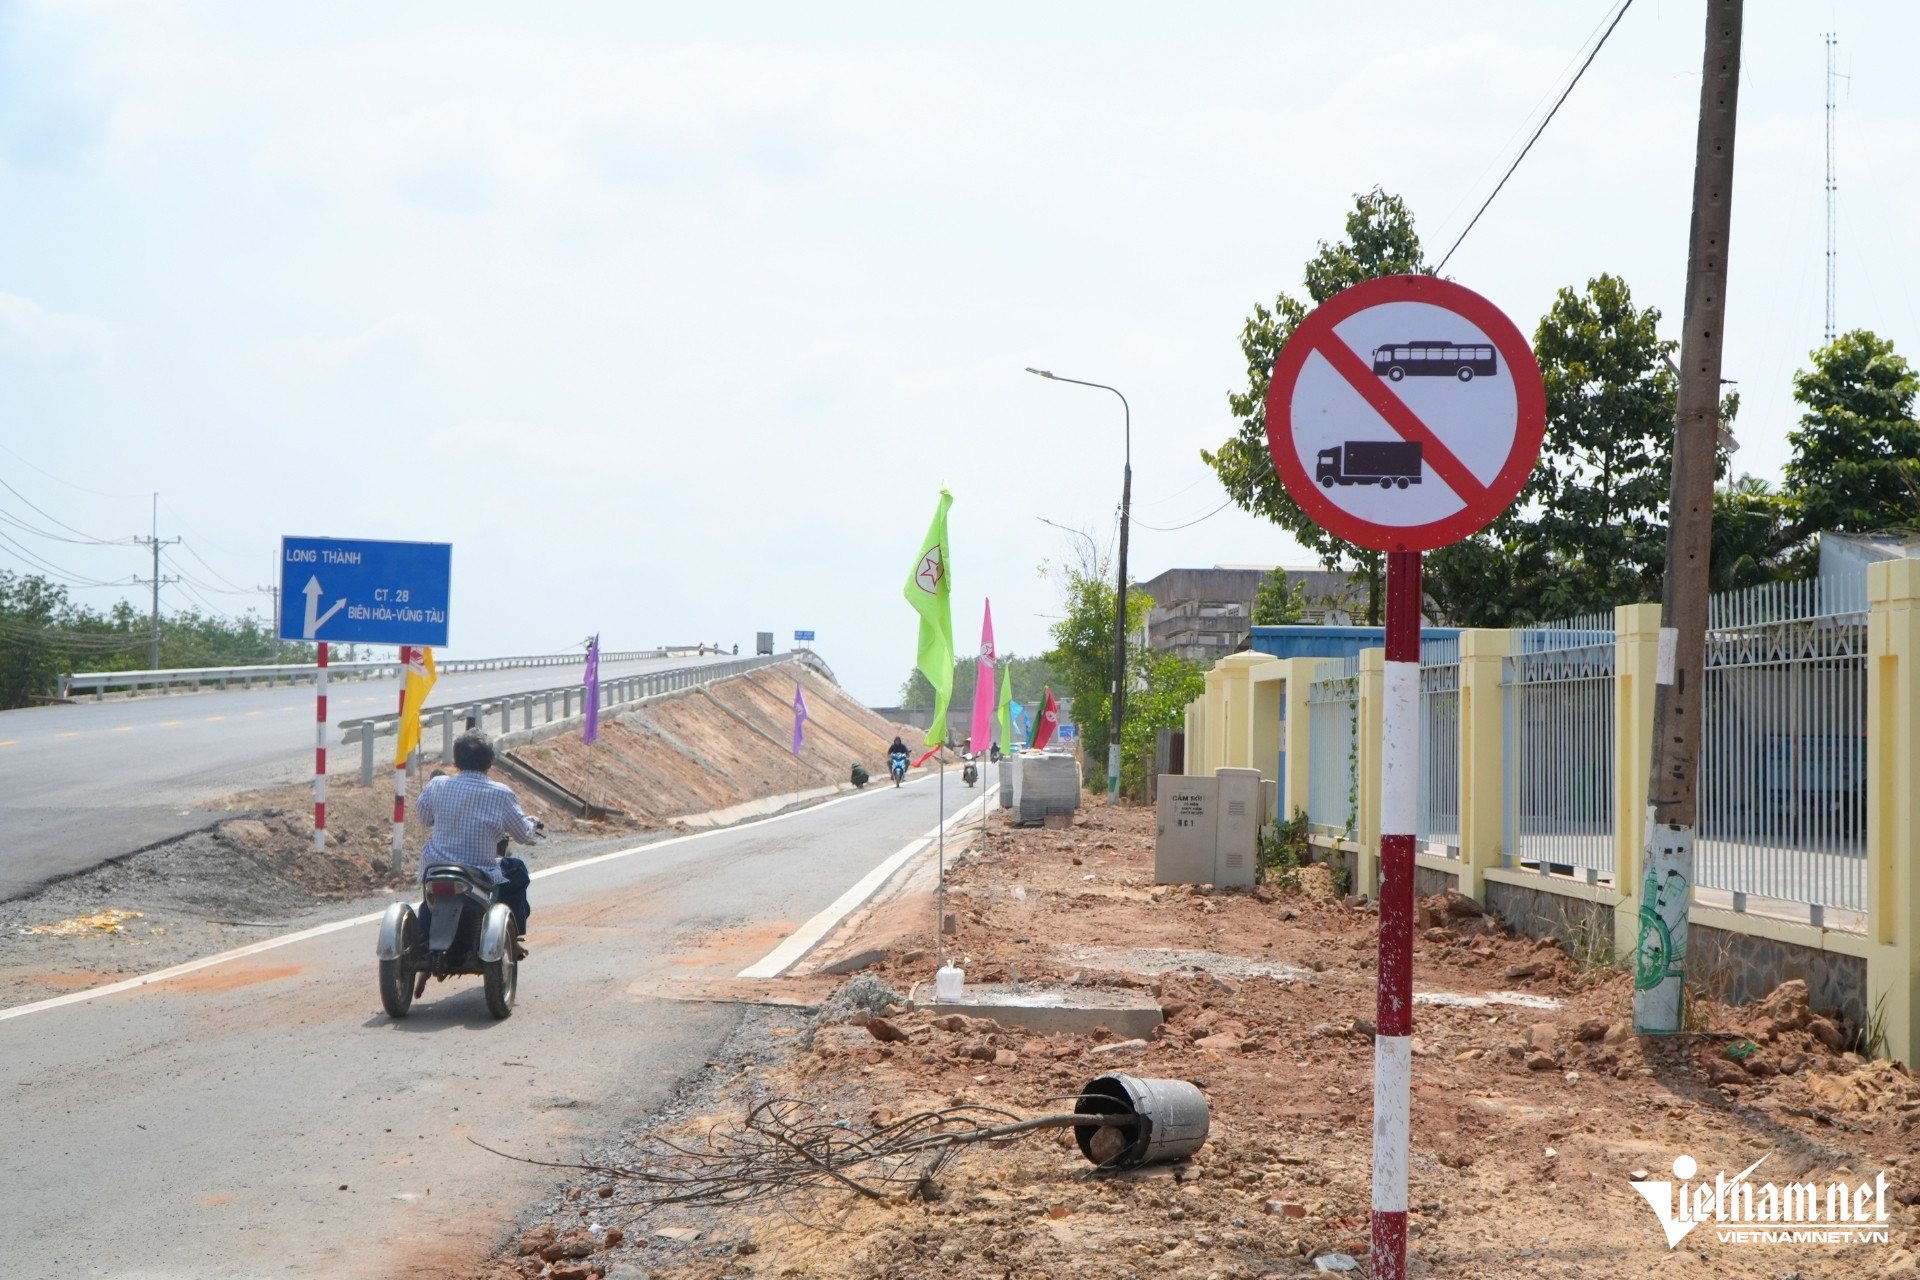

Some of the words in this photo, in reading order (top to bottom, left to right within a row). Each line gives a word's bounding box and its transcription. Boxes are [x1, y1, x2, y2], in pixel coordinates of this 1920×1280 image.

[286, 549, 317, 563] LONG
[322, 548, 361, 565] THÀNH
[348, 604, 370, 620] BIÊN
[425, 607, 444, 623] TÀU
